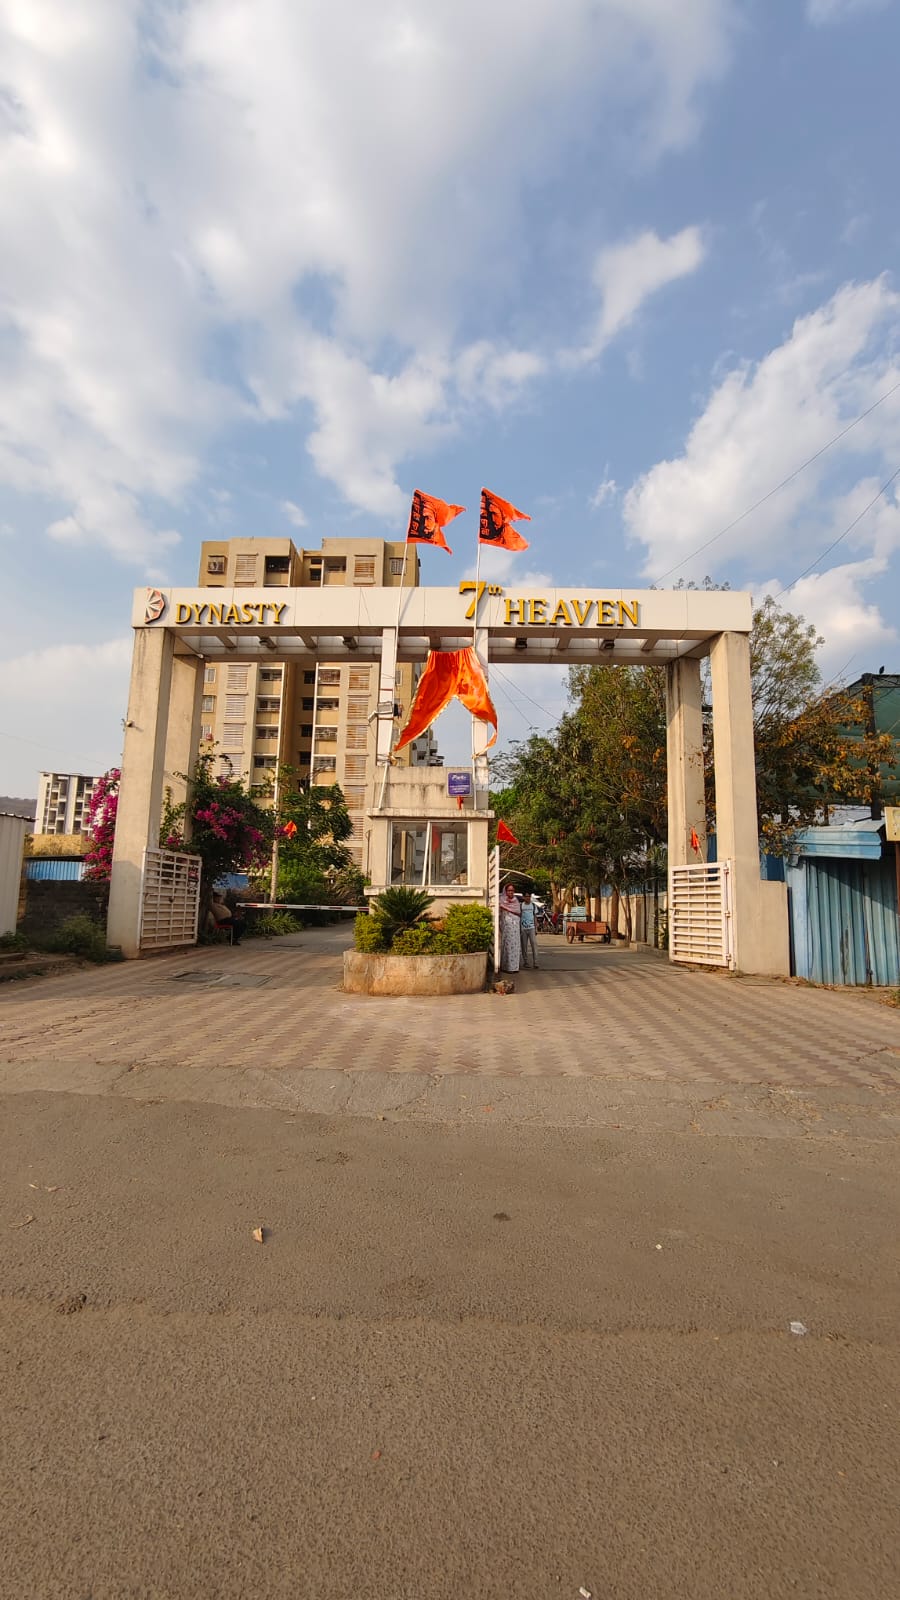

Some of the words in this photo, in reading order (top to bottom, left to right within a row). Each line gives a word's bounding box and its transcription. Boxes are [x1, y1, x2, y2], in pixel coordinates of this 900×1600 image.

[176, 603, 286, 625] DYNASTY
[459, 581, 502, 619] 7th
[504, 598, 639, 626] HEAVEN
